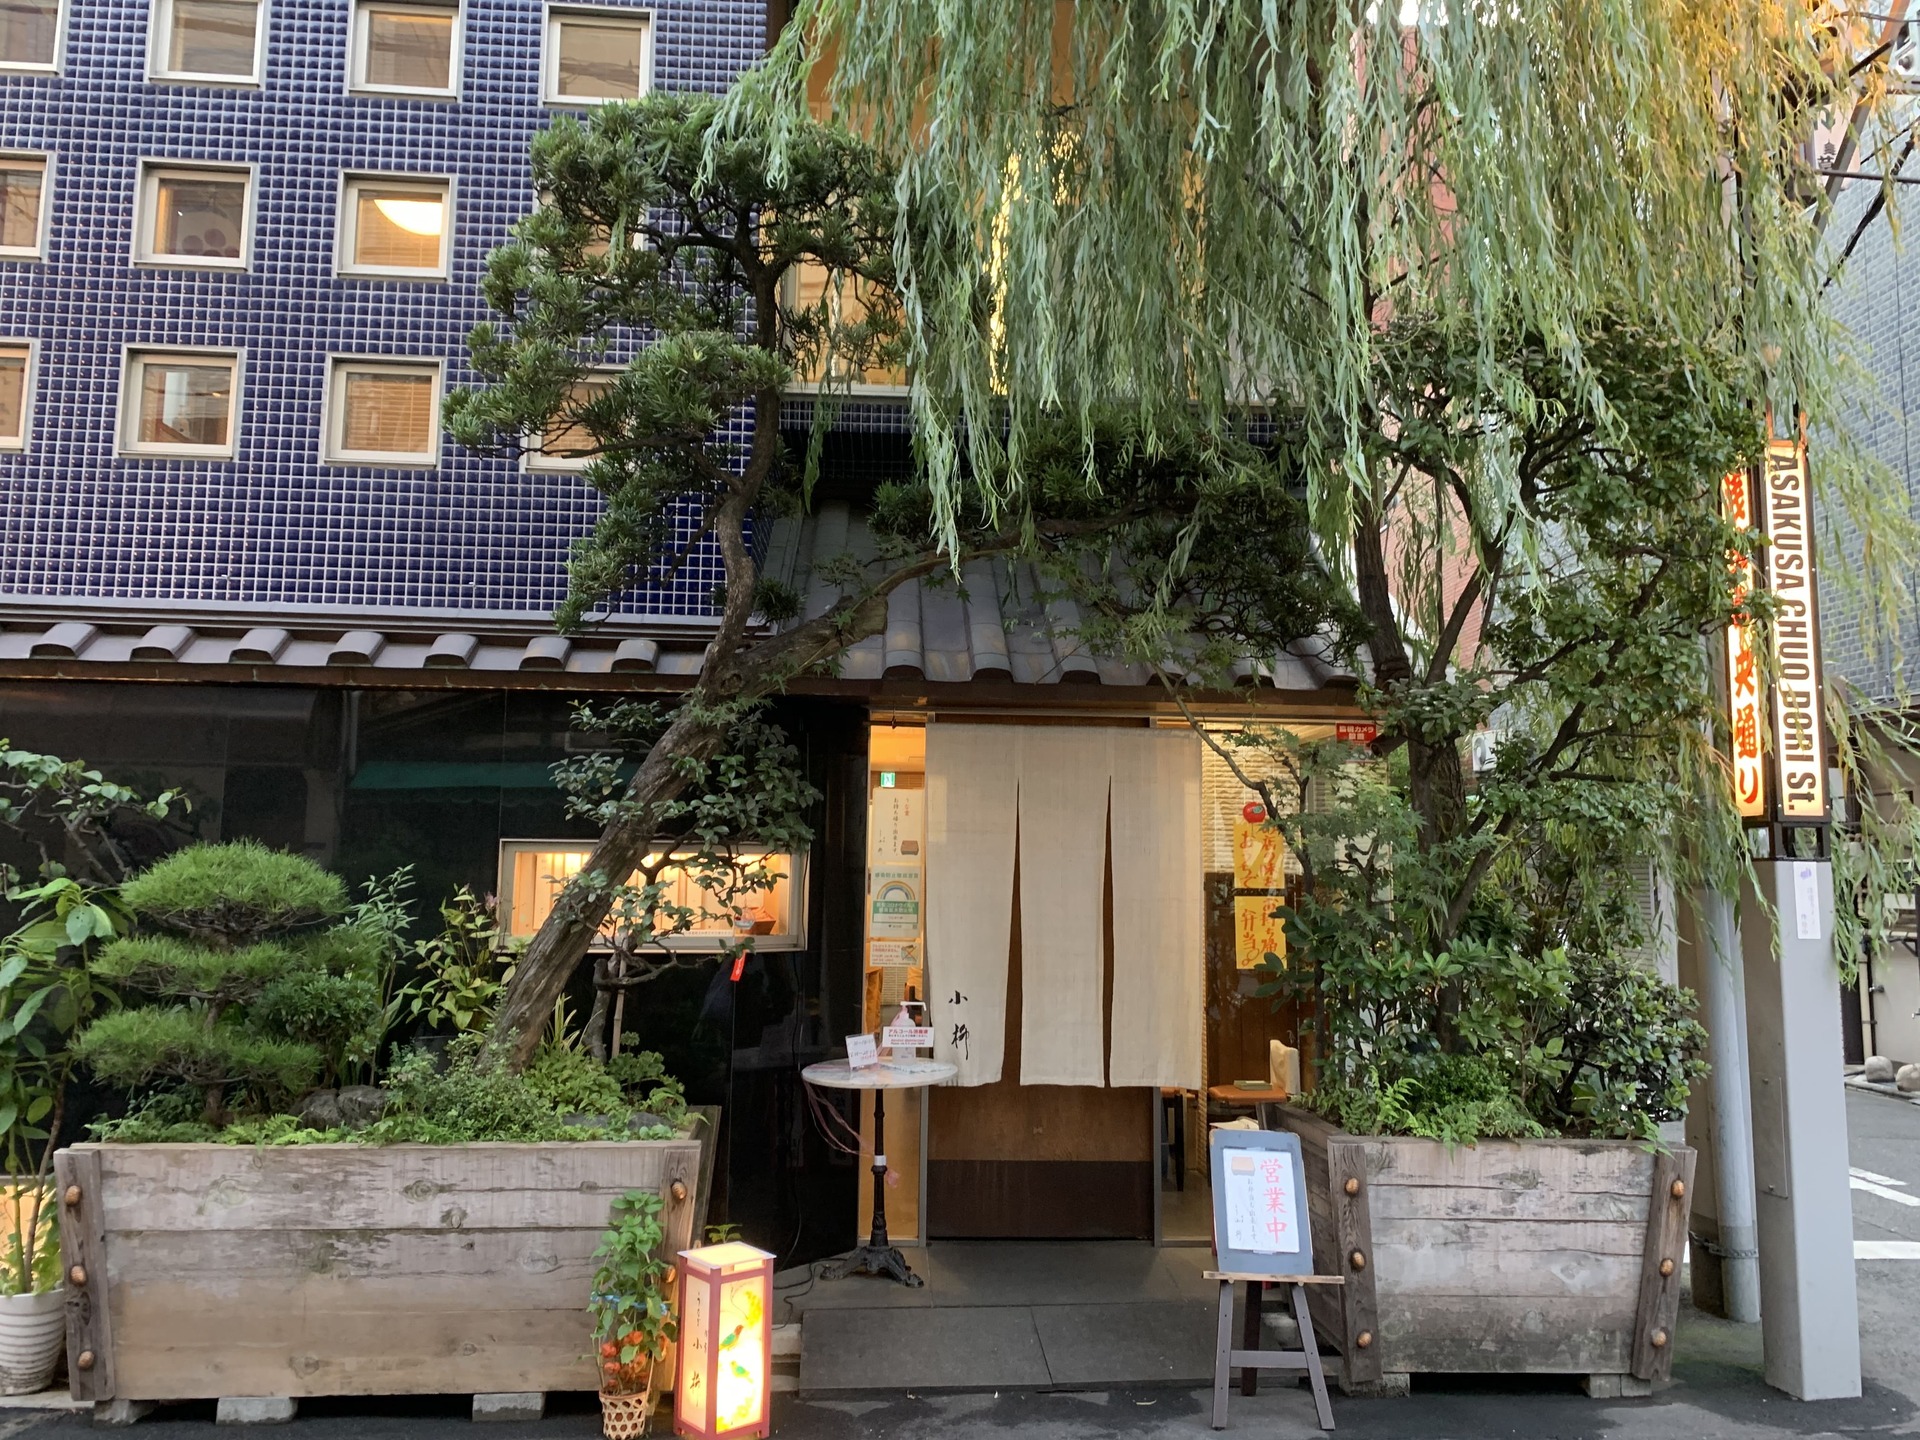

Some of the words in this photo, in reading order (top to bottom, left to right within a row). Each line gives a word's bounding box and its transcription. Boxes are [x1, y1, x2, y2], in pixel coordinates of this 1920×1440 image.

[1770, 453, 1804, 590] ASAKUSA
[1776, 599, 1810, 681] CHUO
[1782, 690, 1815, 762] DORI
[1787, 772, 1817, 811] St.
[1259, 1157, 1288, 1245] 営業中
